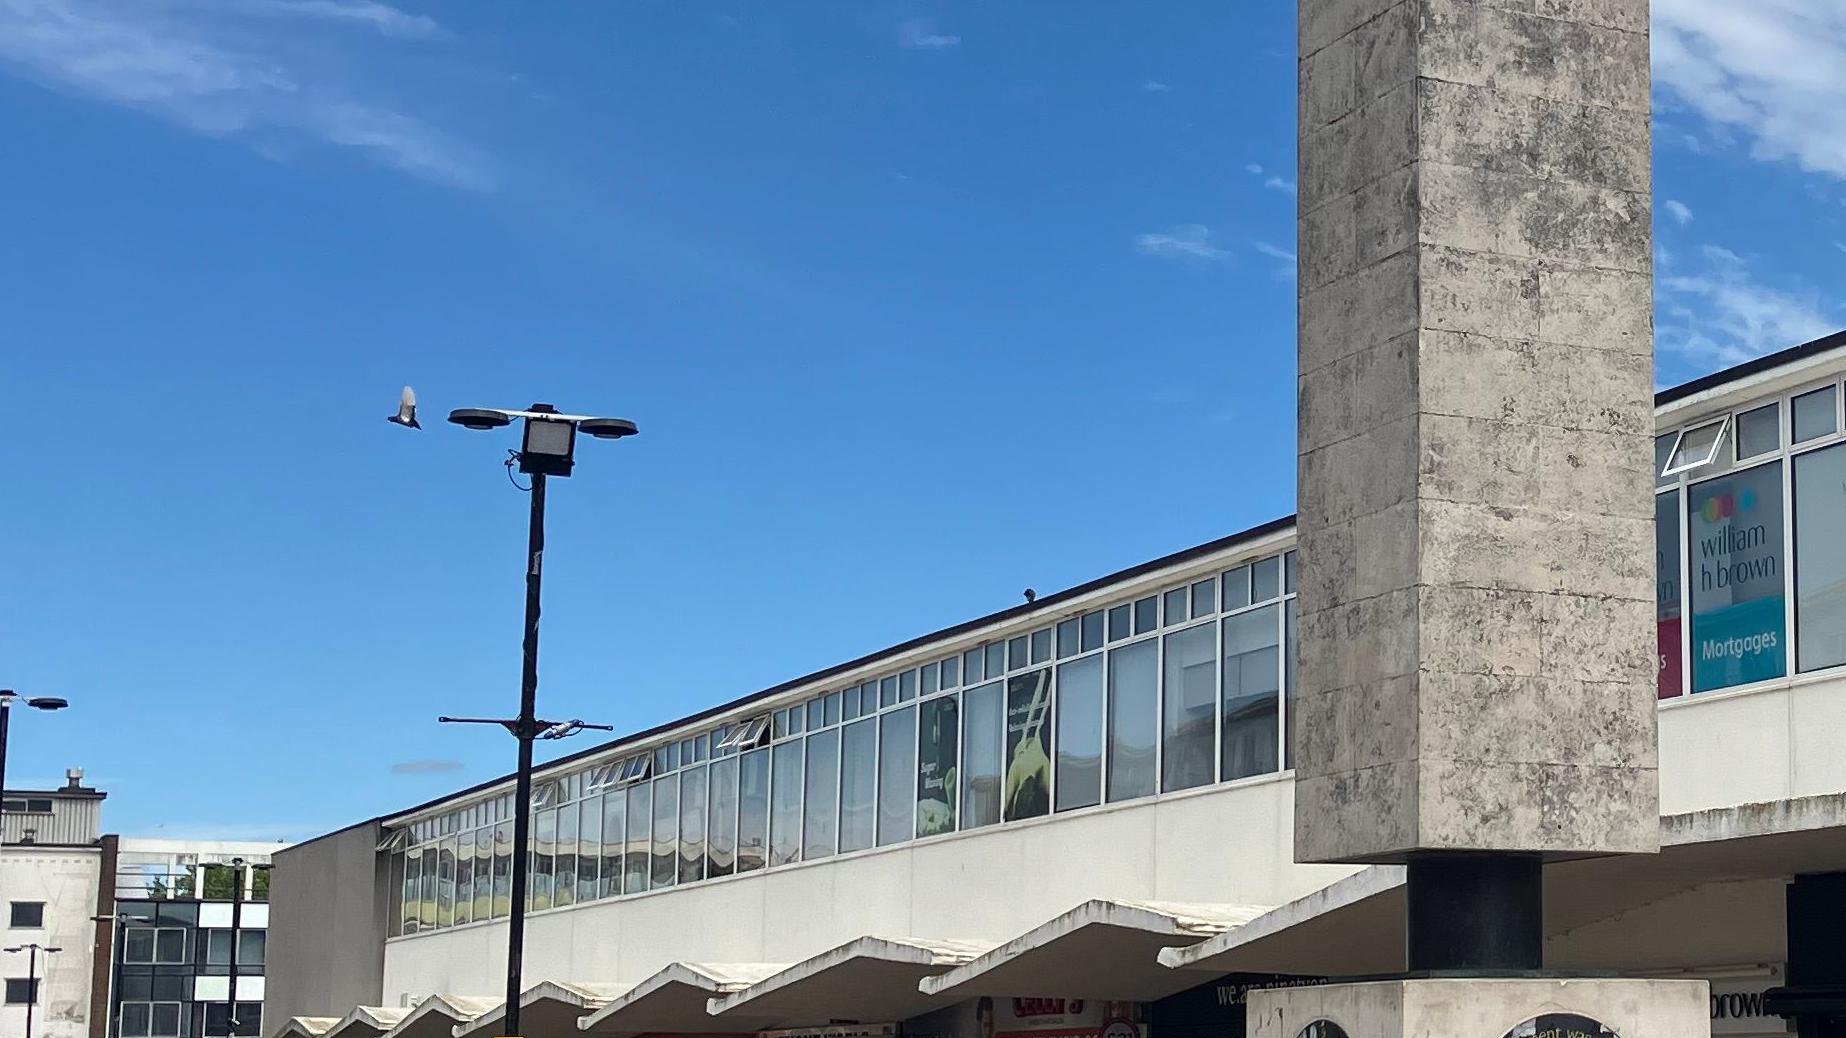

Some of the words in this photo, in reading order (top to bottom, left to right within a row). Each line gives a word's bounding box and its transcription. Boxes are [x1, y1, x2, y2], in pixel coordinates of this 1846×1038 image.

[1701, 524, 1765, 558] william
[1701, 562, 1713, 592] h
[1717, 555, 1776, 589] brown
[1702, 630, 1777, 661] Mortgages
